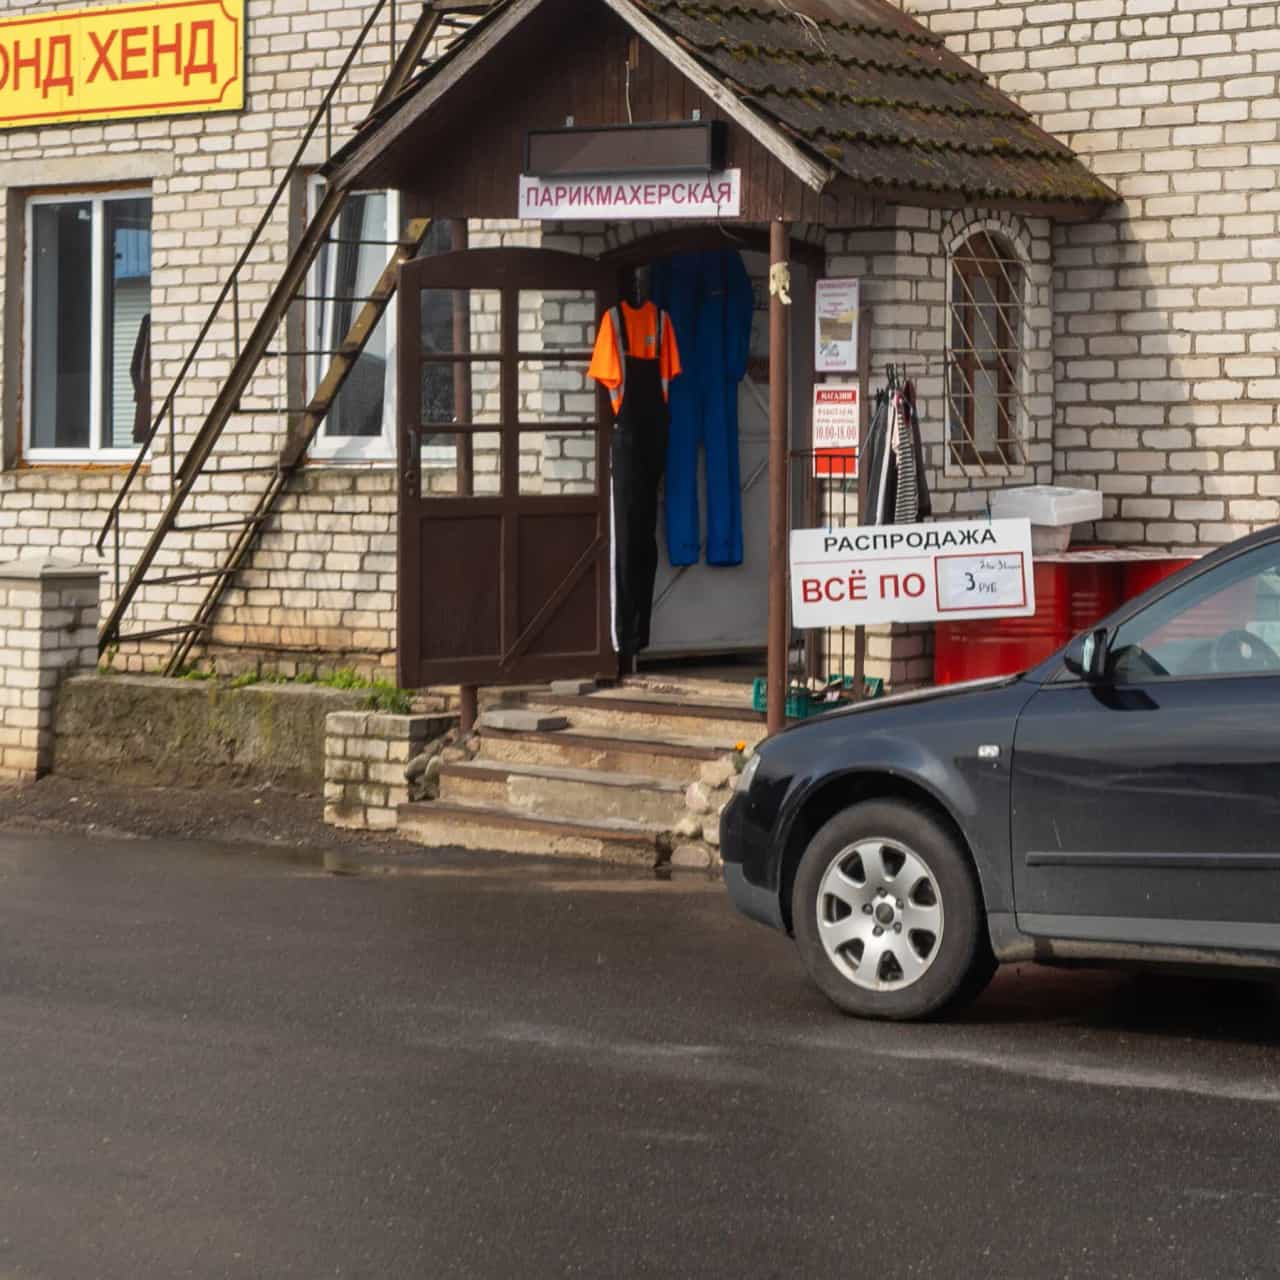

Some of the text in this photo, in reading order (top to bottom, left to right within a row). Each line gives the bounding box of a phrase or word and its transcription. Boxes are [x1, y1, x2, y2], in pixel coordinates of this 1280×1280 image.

[85, 19, 218, 87] ХЕНД
[526, 182, 732, 207] ПАРИКМАХЕРСКАЯ
[824, 528, 998, 553] РАСПРОДАЖА
[801, 569, 868, 603] ВСЁ
[879, 573, 926, 599] ПО
[964, 571, 976, 592] 3
